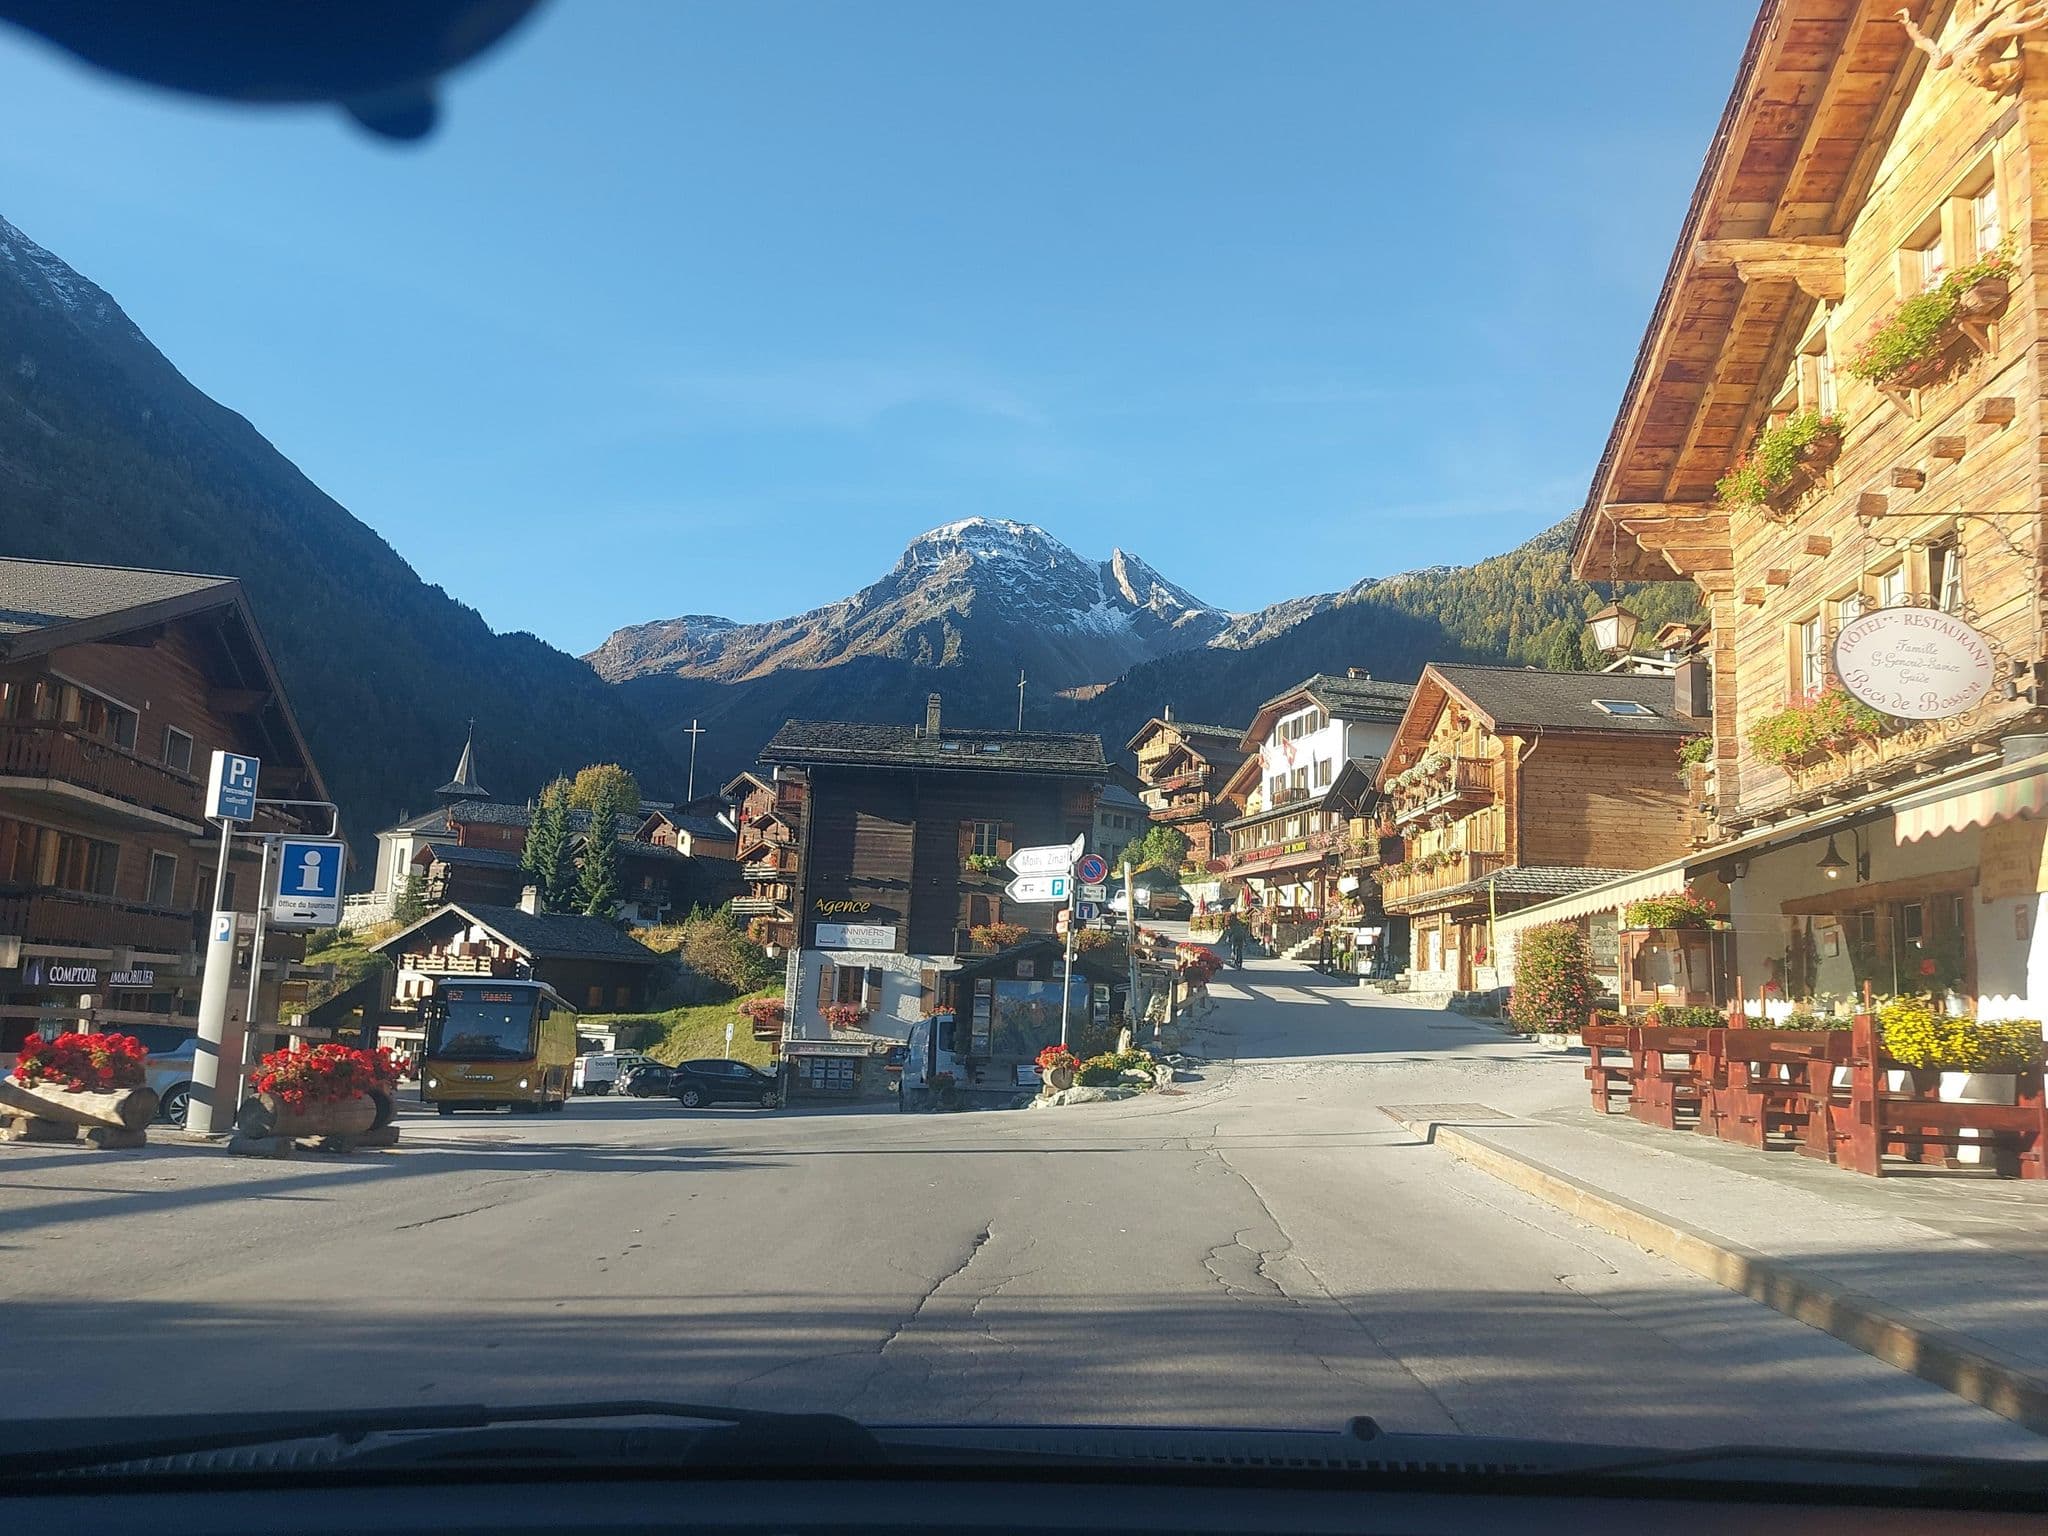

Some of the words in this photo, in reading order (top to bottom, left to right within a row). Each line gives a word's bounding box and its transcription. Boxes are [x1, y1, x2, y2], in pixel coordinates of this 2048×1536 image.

[1896, 639, 1938, 655] Famille
[1904, 613, 1989, 669] RESTAURANT
[1846, 669, 1886, 704] Becs
[1891, 692, 1910, 710] de
[229, 757, 247, 785] P
[278, 900, 297, 908] Office
[298, 901, 307, 909] du
[308, 902, 336, 910] tourisme
[812, 898, 871, 916] Agence
[215, 917, 230, 940] P
[841, 927, 886, 937] ANNIVIERS
[49, 966, 97, 983] COMPTOIR
[109, 970, 154, 985] IMMOBILIER
